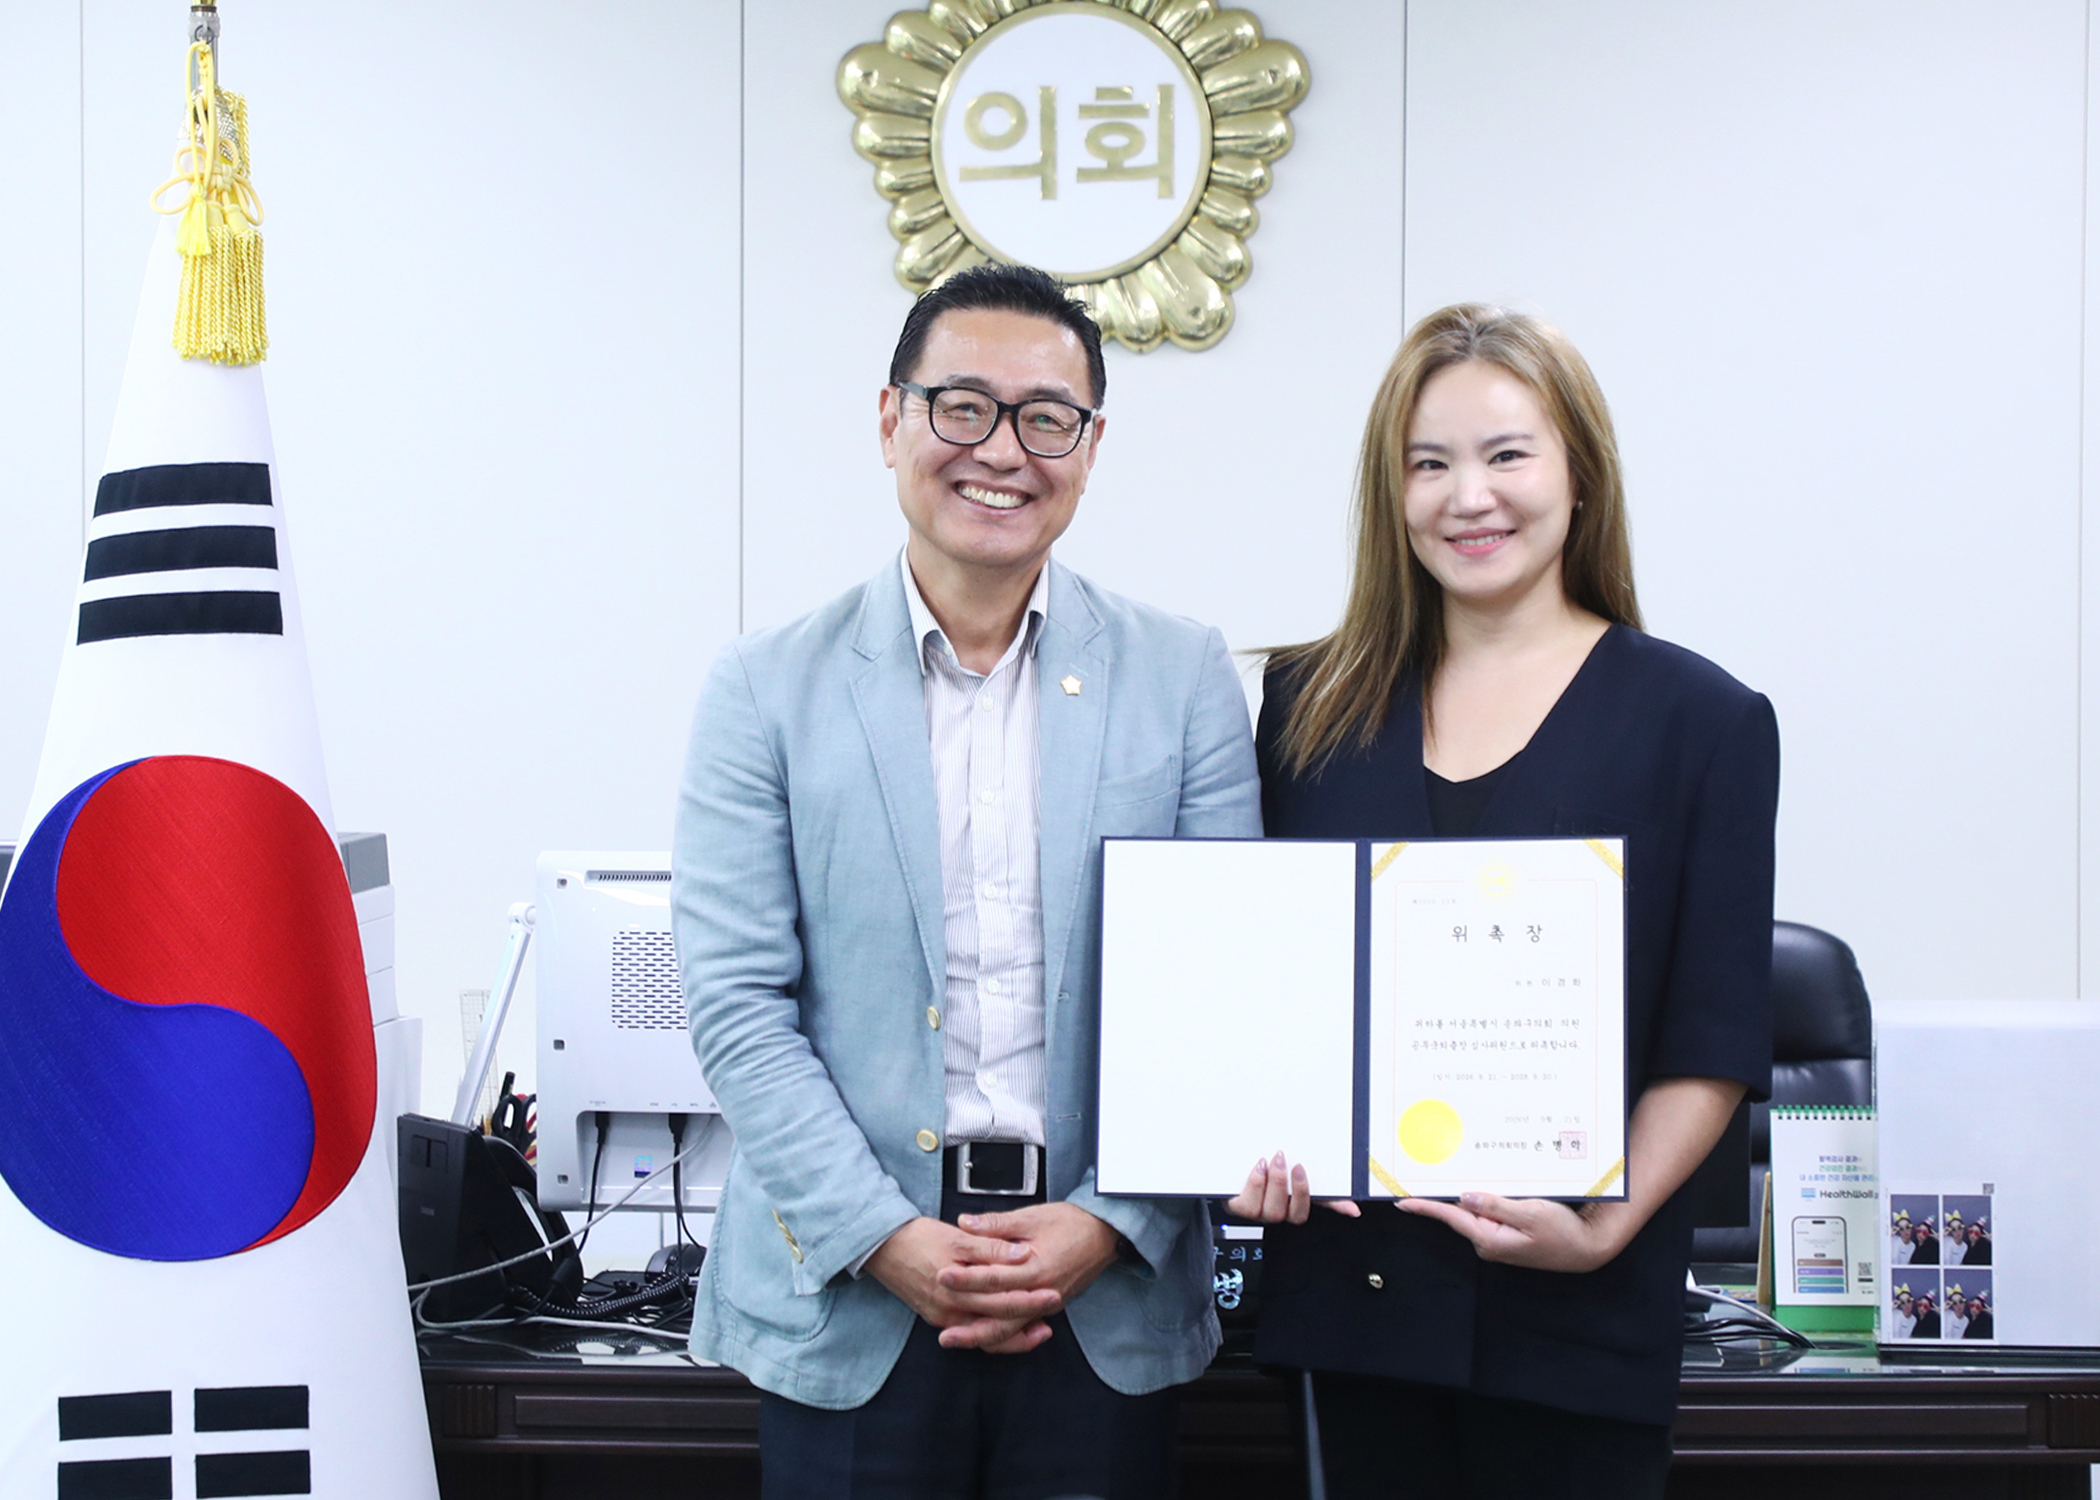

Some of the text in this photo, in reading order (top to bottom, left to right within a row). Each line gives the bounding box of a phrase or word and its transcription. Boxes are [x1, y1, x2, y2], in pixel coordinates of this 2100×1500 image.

[959, 84, 1175, 201] 의회
[1452, 924, 1467, 943] 위
[1526, 924, 1544, 943] 장
